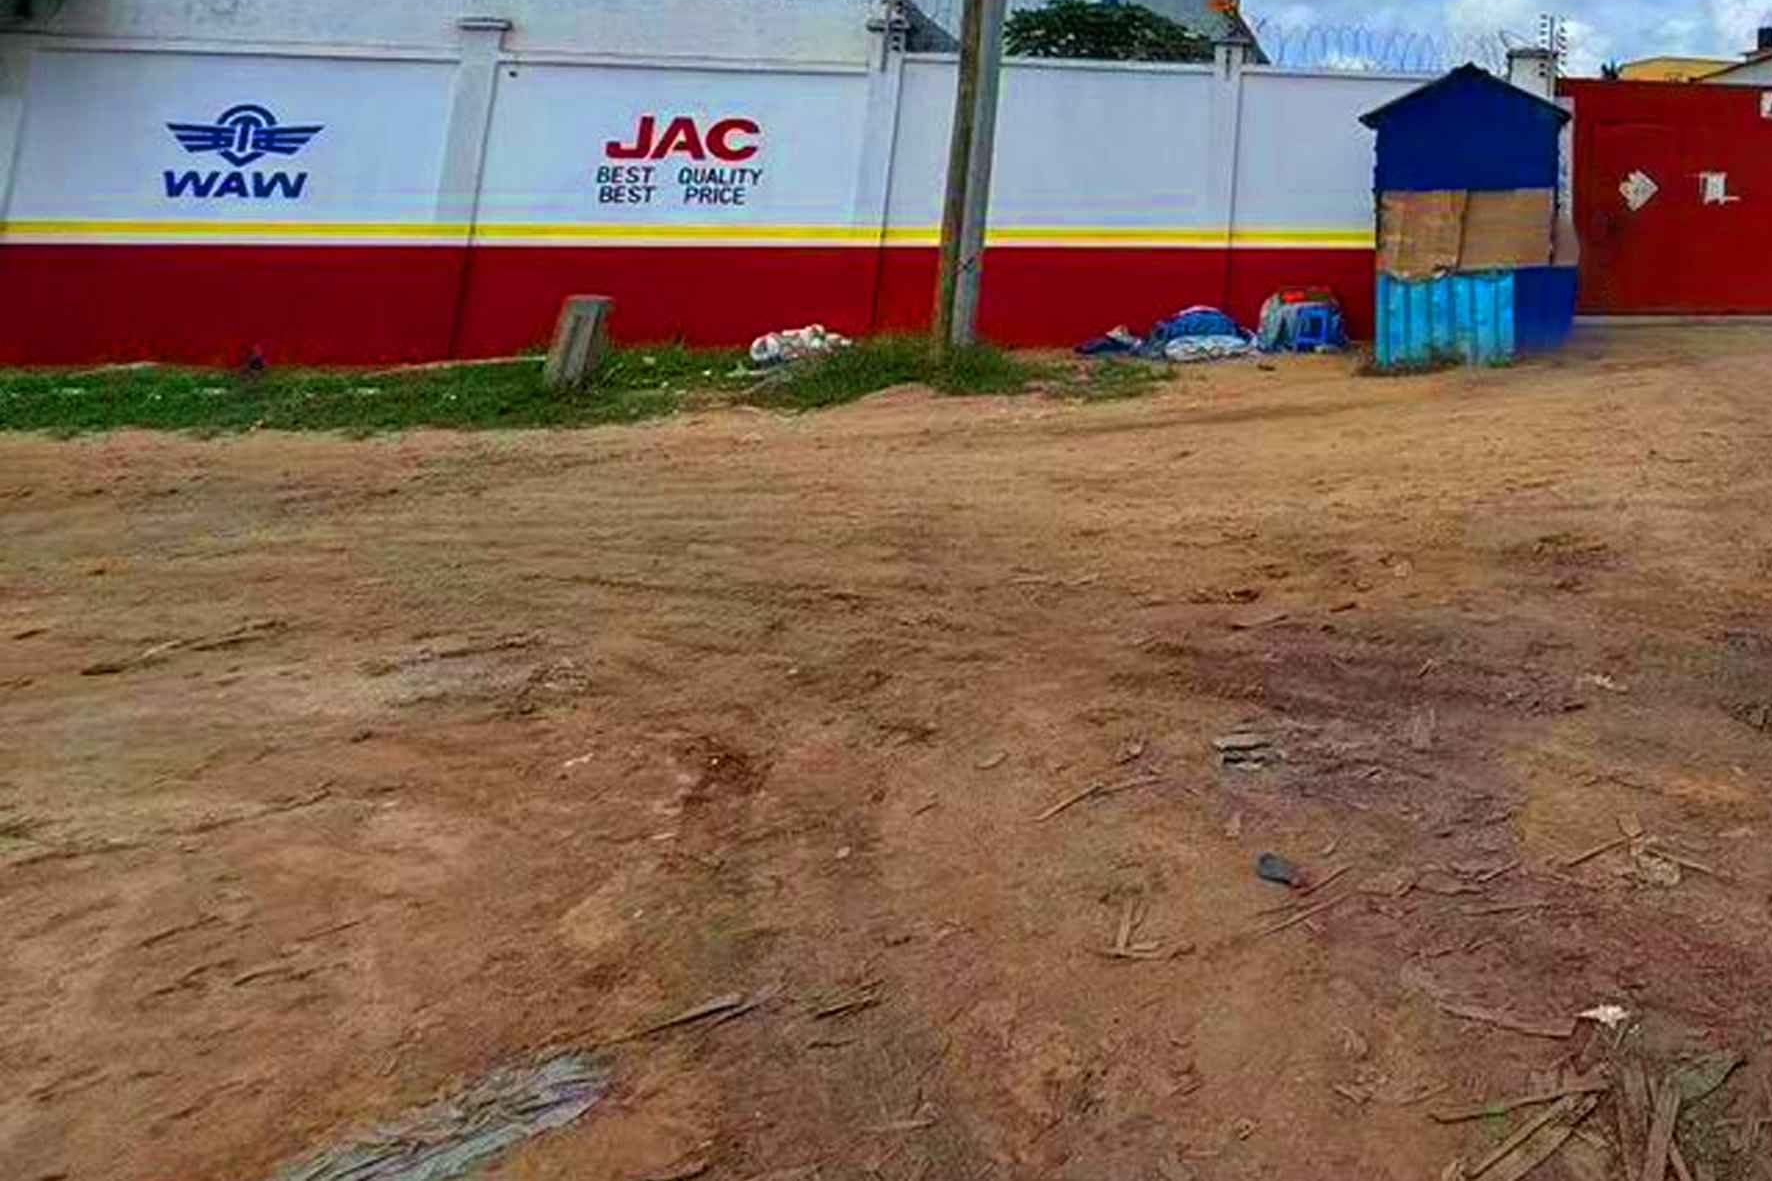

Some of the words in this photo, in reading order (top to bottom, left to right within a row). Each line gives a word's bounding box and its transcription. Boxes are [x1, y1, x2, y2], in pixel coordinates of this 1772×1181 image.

[605, 115, 760, 161] JAC
[163, 171, 308, 198] WAW
[596, 166, 655, 183] BEST
[677, 167, 763, 185] QUALITY
[599, 186, 655, 204] BEST
[684, 186, 746, 205] PRICE
